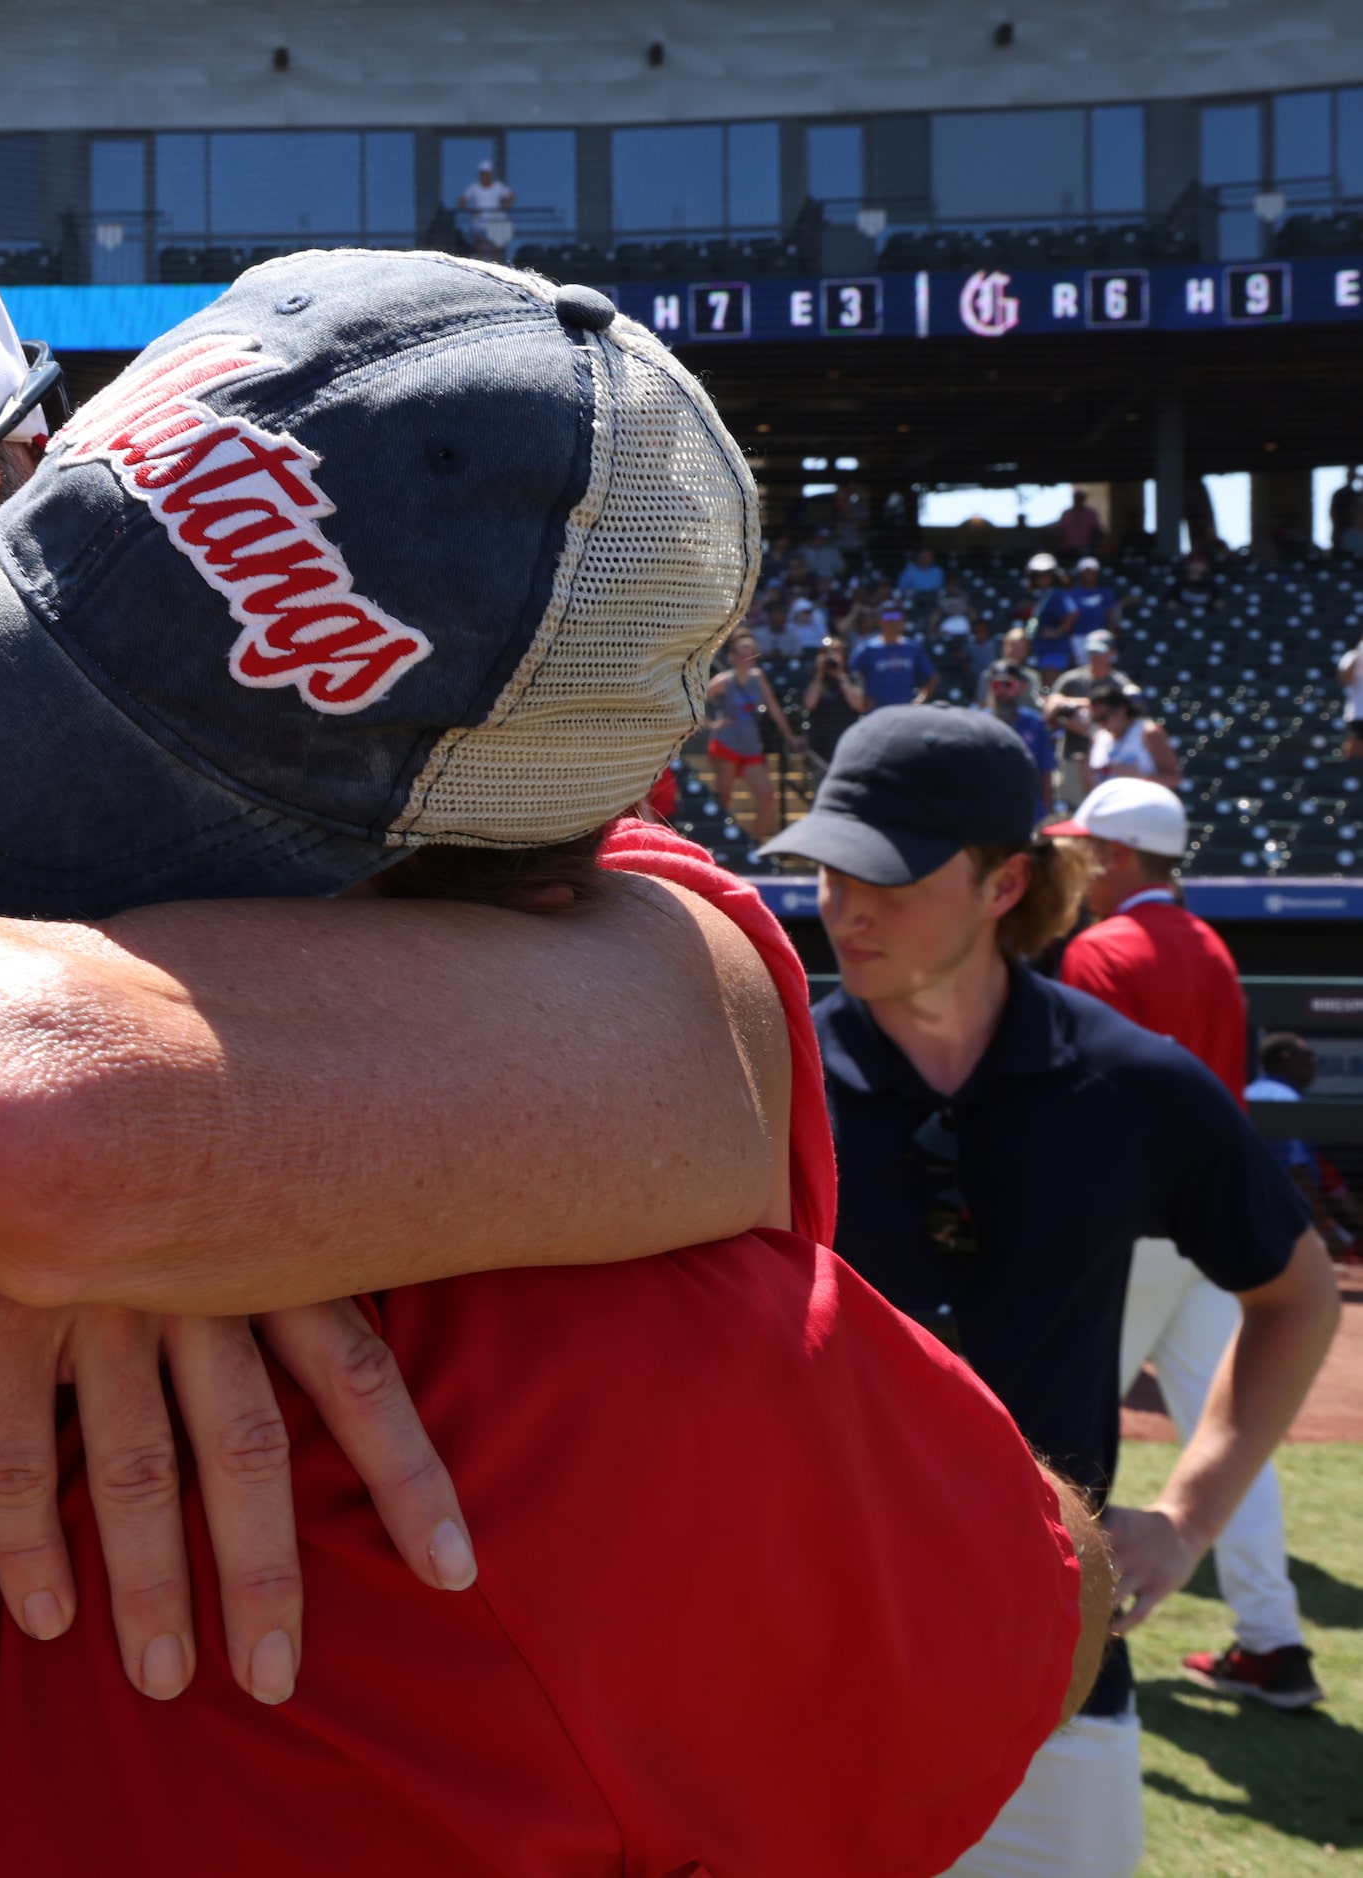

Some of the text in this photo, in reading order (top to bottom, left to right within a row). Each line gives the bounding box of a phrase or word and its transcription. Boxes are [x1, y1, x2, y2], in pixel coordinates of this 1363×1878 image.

[653, 295, 680, 330] H
[707, 291, 730, 330] 7
[790, 291, 813, 326] E
[838, 286, 862, 327] 3
[1052, 282, 1078, 318] R
[1104, 278, 1128, 320] 6
[1185, 278, 1215, 313] H
[1246, 273, 1270, 315] 9
[1334, 270, 1361, 306] E
